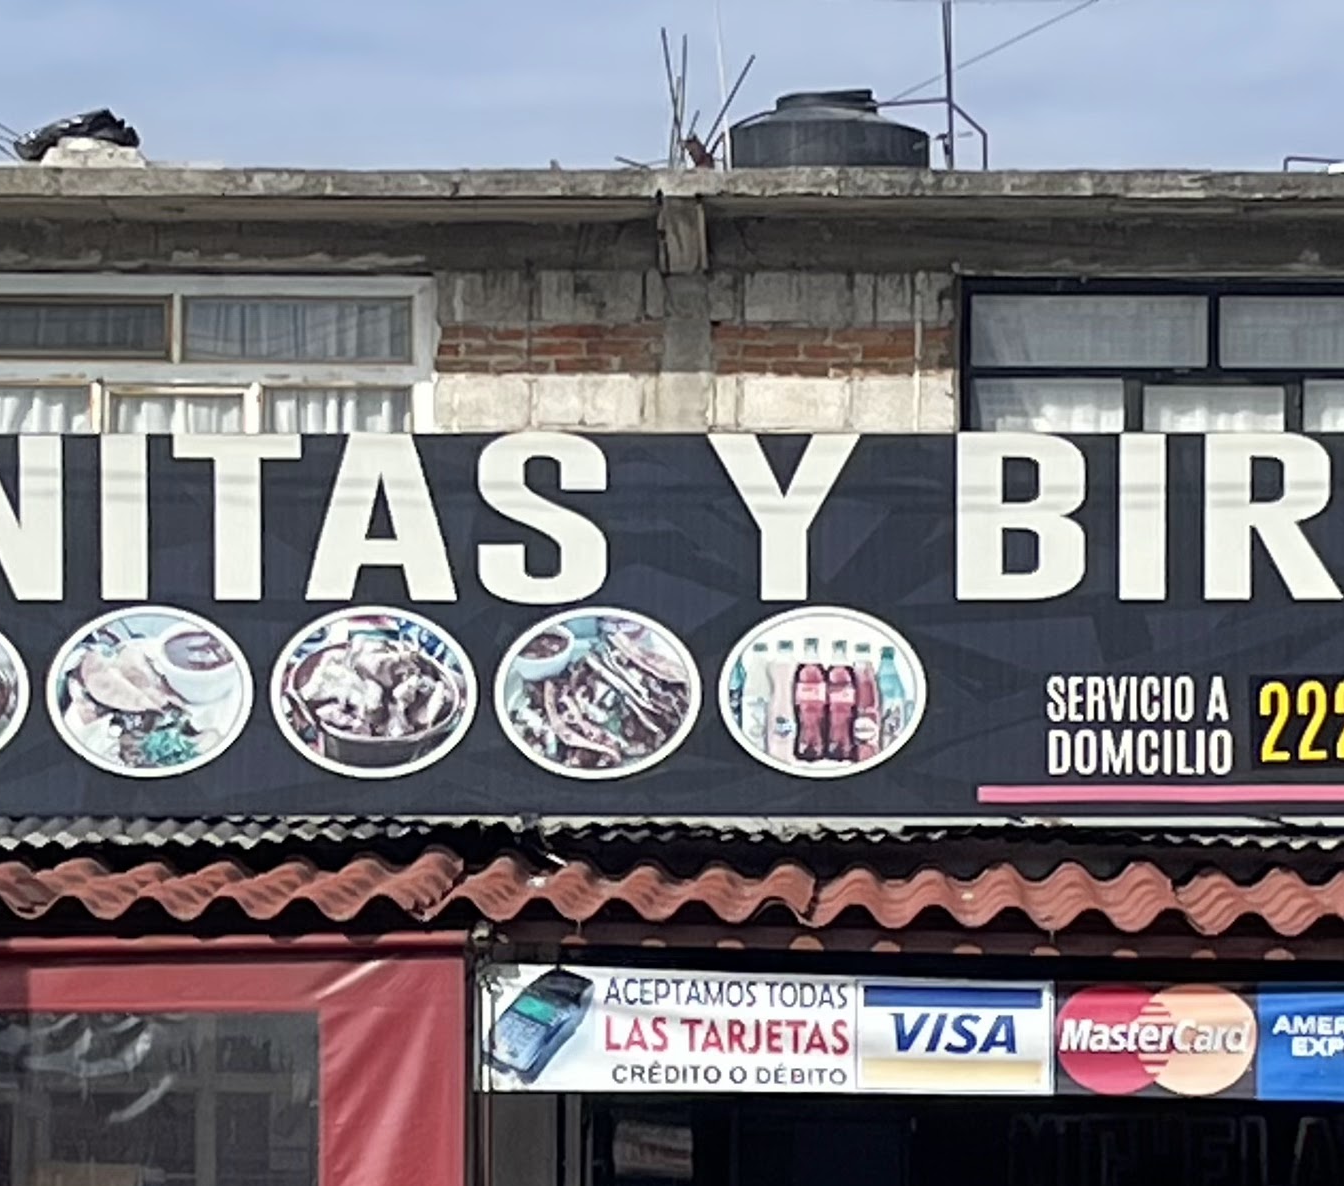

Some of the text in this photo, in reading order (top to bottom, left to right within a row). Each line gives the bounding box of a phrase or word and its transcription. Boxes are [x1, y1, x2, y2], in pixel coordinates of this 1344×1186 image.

[707, 431, 861, 602] Y
[1045, 674, 1230, 723] SERVICIO A
[1046, 728, 1235, 777] DOMCILIO
[602, 976, 848, 1010] ACEPTAMOS TODAS
[604, 1014, 850, 1056] LAS TARJETAS
[888, 1012, 1017, 1055] VISA
[1059, 1018, 1254, 1053] MasterCard
[611, 1060, 848, 1086] CRÉDITO O DÉBITO
